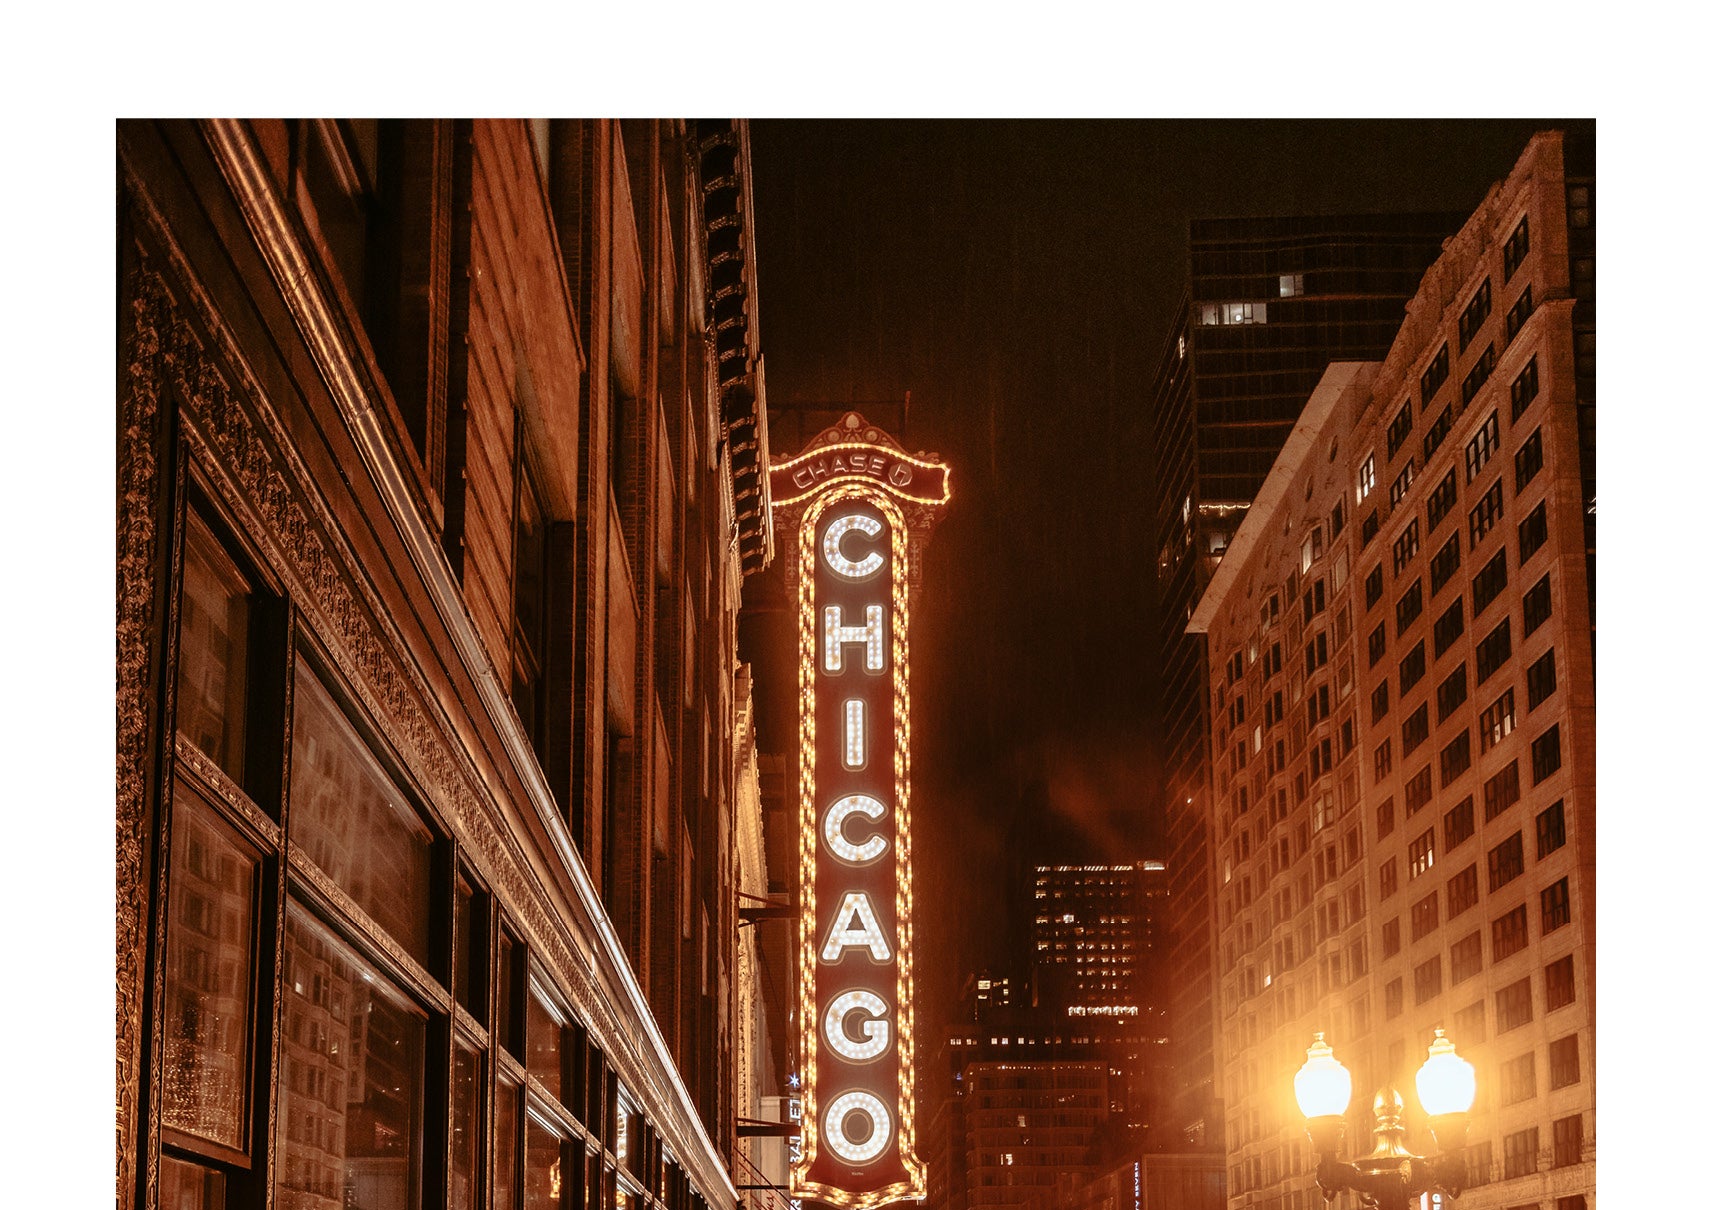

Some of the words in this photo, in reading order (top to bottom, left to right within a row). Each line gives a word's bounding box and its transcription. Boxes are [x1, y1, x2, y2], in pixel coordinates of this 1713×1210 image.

[792, 454, 885, 489] CHASE
[823, 514, 892, 1162] CHICAGO
[789, 1098, 801, 1163] BALET
